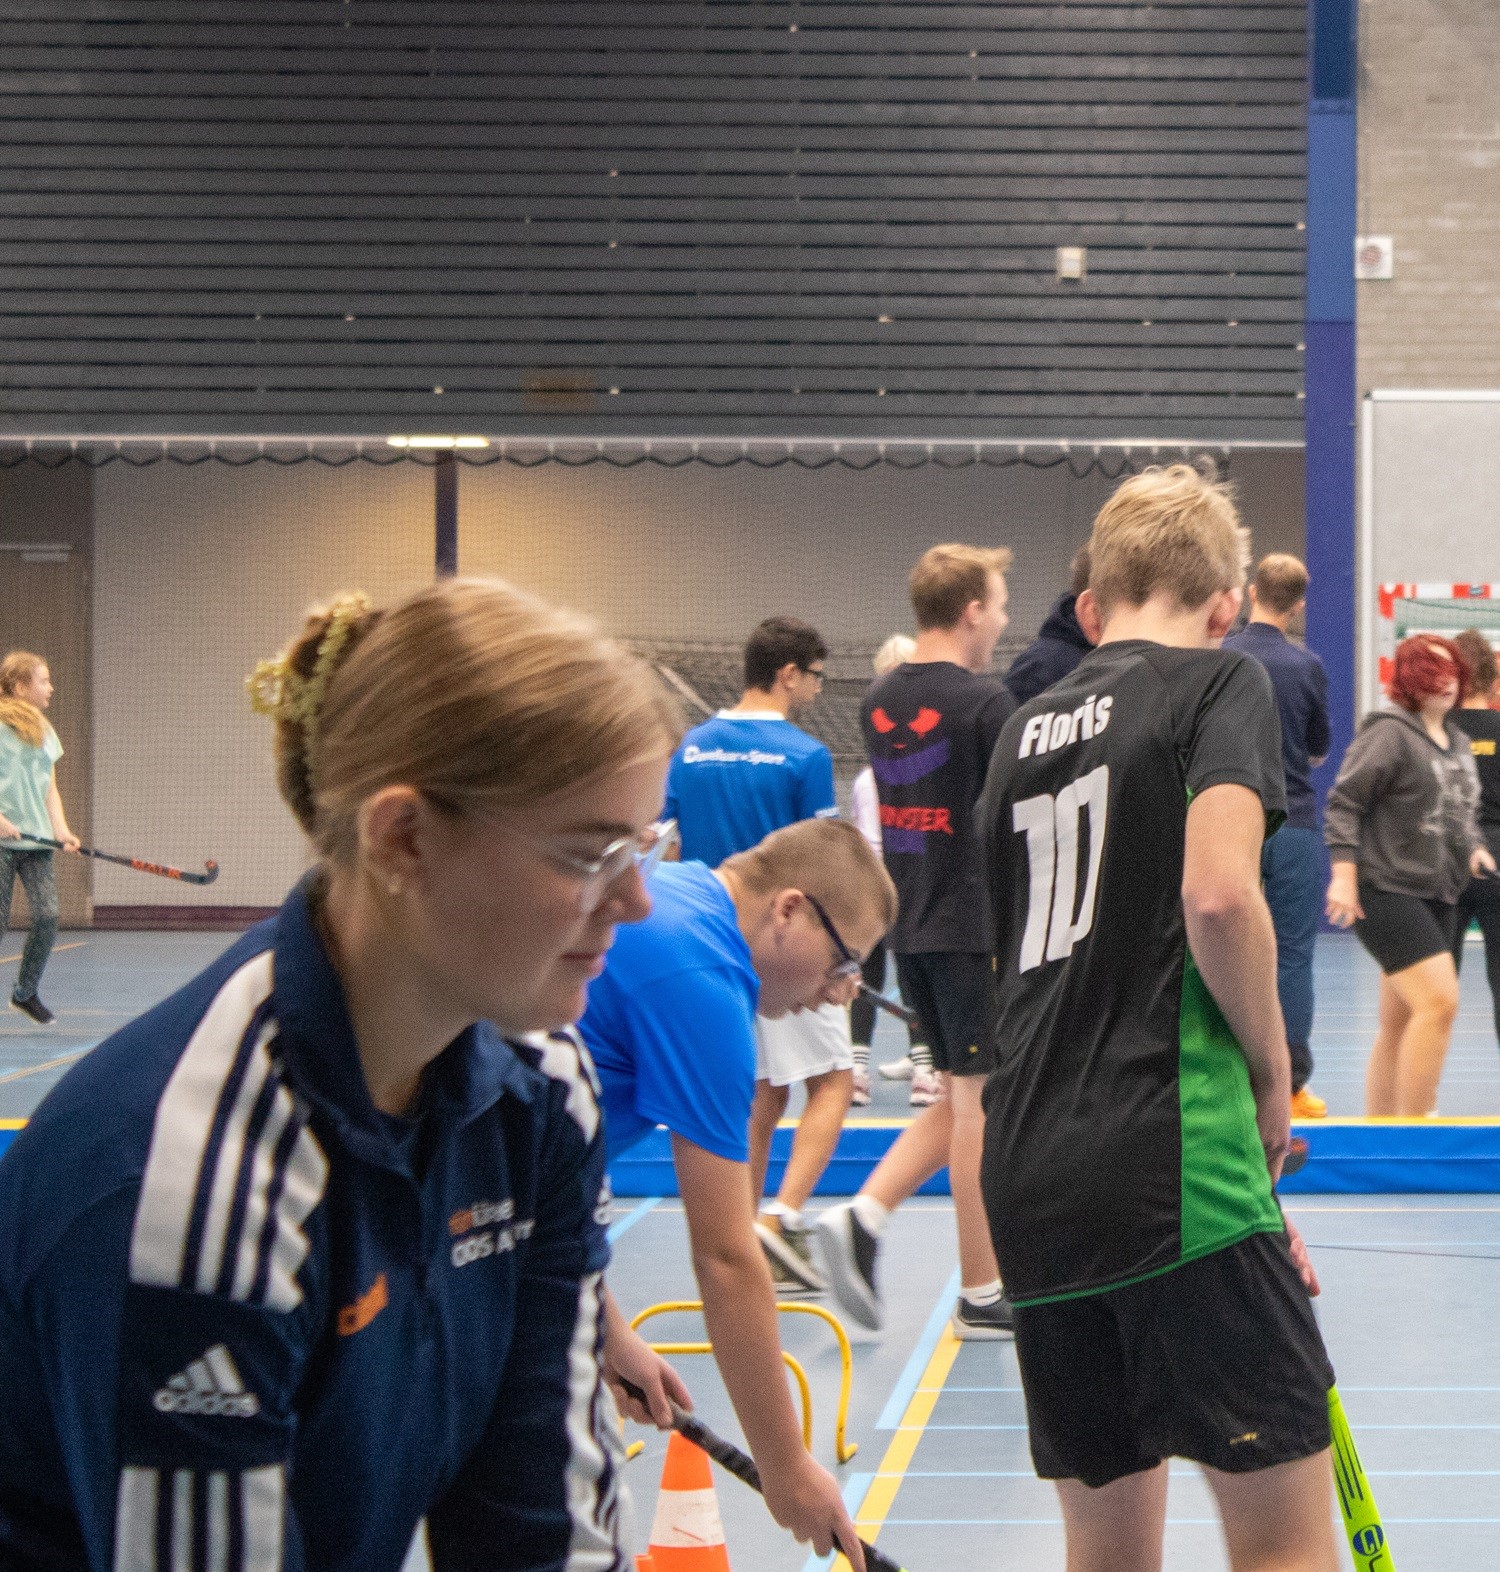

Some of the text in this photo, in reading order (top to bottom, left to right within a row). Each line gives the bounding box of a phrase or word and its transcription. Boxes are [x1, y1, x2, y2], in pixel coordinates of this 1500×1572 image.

[1018, 694, 1114, 760] Floris
[1012, 764, 1110, 975] 10
[153, 1388, 261, 1418] adidas
